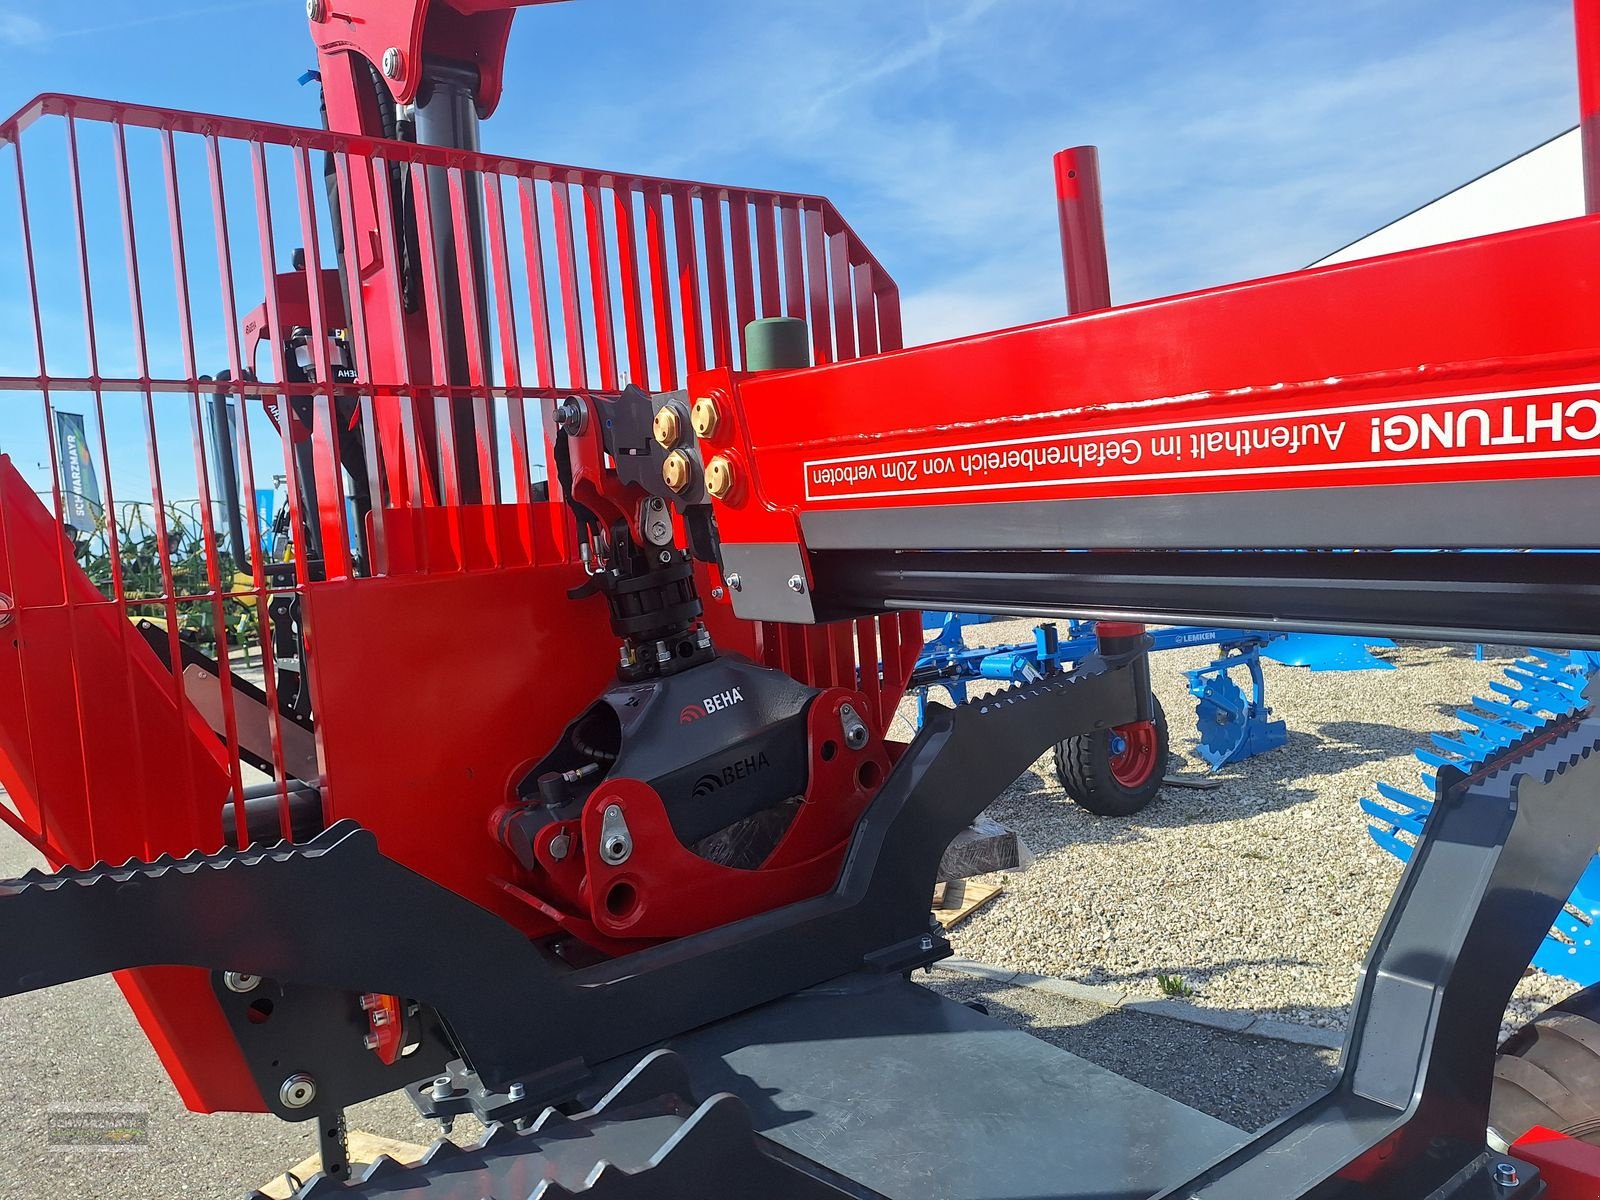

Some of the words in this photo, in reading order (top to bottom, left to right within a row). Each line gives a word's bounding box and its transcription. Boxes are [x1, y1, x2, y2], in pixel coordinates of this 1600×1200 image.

[1151, 436, 1182, 460] im
[1189, 421, 1346, 460] Aufenthalt
[922, 457, 956, 476] von
[960, 438, 1142, 478] Gefahrenbereich
[67, 434, 85, 517] SCHWARZMAYR
[813, 464, 877, 486] verboten
[881, 460, 918, 482] 20m
[1183, 631, 1216, 643] LEMKEN
[722, 751, 770, 786] BEHA
